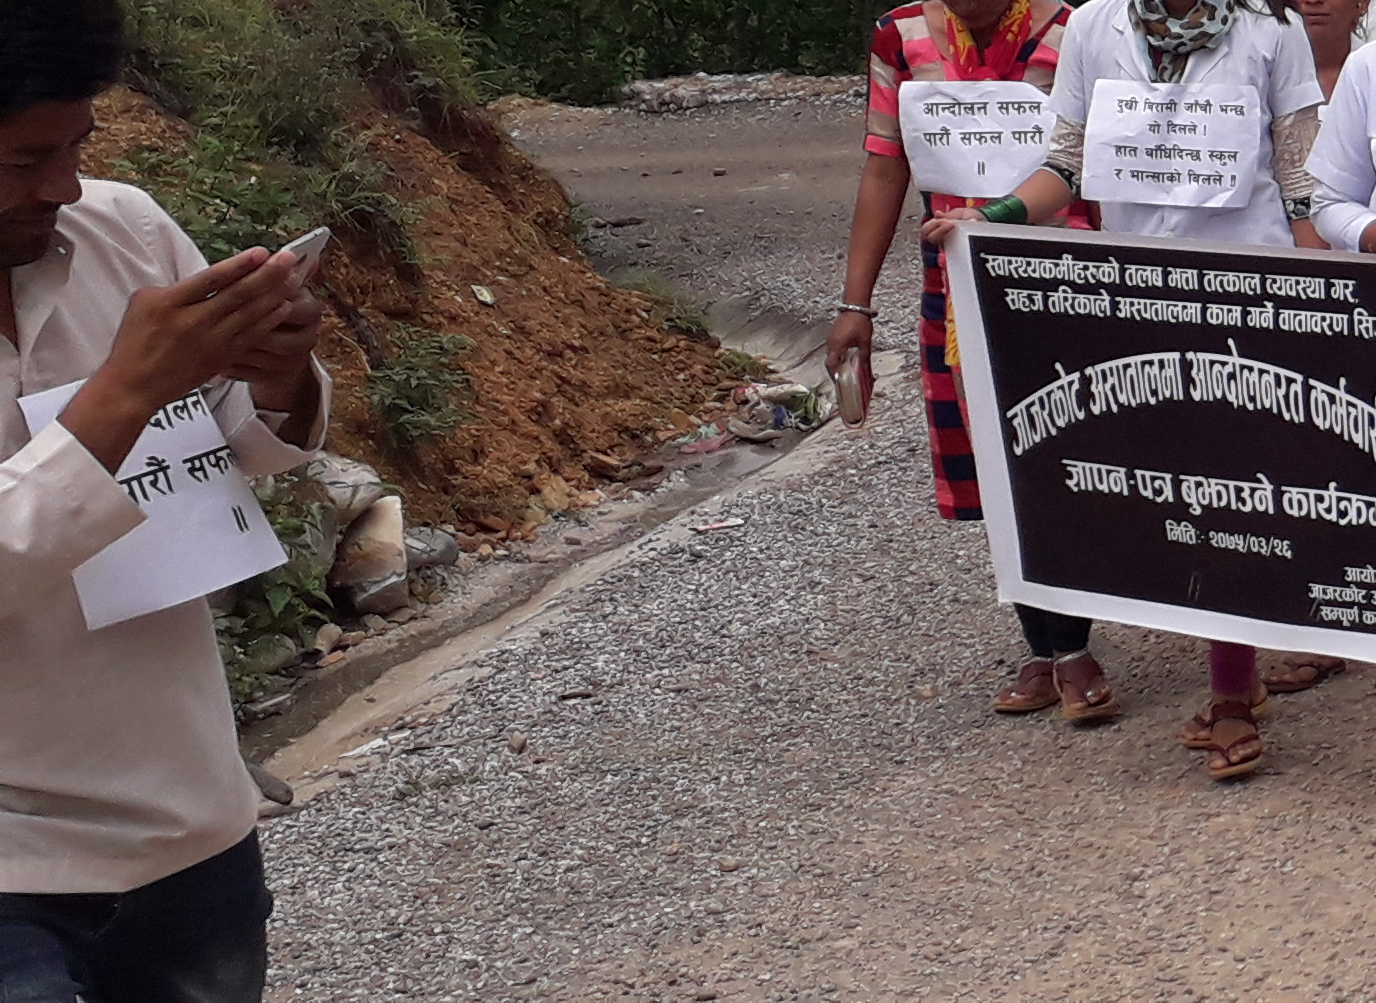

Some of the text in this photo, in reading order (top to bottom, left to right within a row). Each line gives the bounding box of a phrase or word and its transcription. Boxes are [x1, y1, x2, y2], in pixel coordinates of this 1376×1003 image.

[923, 97, 1043, 117] आन्दोलन सफल
[958, 131, 1005, 147] सफल
[1166, 120, 1199, 136] दिलले
[1114, 144, 1139, 158] हात
[1207, 149, 1239, 167] स्कुल
[1124, 263, 1163, 288] तलब
[1167, 267, 1199, 291] भत्ता
[1203, 269, 1261, 295] तत्काल
[1265, 274, 1325, 300] व्यवस्था
[1004, 288, 1044, 312] सहज
[1047, 286, 1111, 317] तरिकाले
[1115, 296, 1203, 324] अस्पतालमा
[1206, 303, 1242, 327] काम
[1246, 301, 1275, 330] गर्ने
[1279, 309, 1349, 336] वातावरण
[1006, 362, 1085, 456] जाजरकोट
[1085, 352, 1184, 415] अस्पतालमा
[1185, 338, 1305, 424] आन्दोलनरत
[1178, 473, 1275, 516] बुझाउने
[1309, 583, 1367, 604] जाजरकोट
[1320, 604, 1359, 627] सम्पूर्ण
